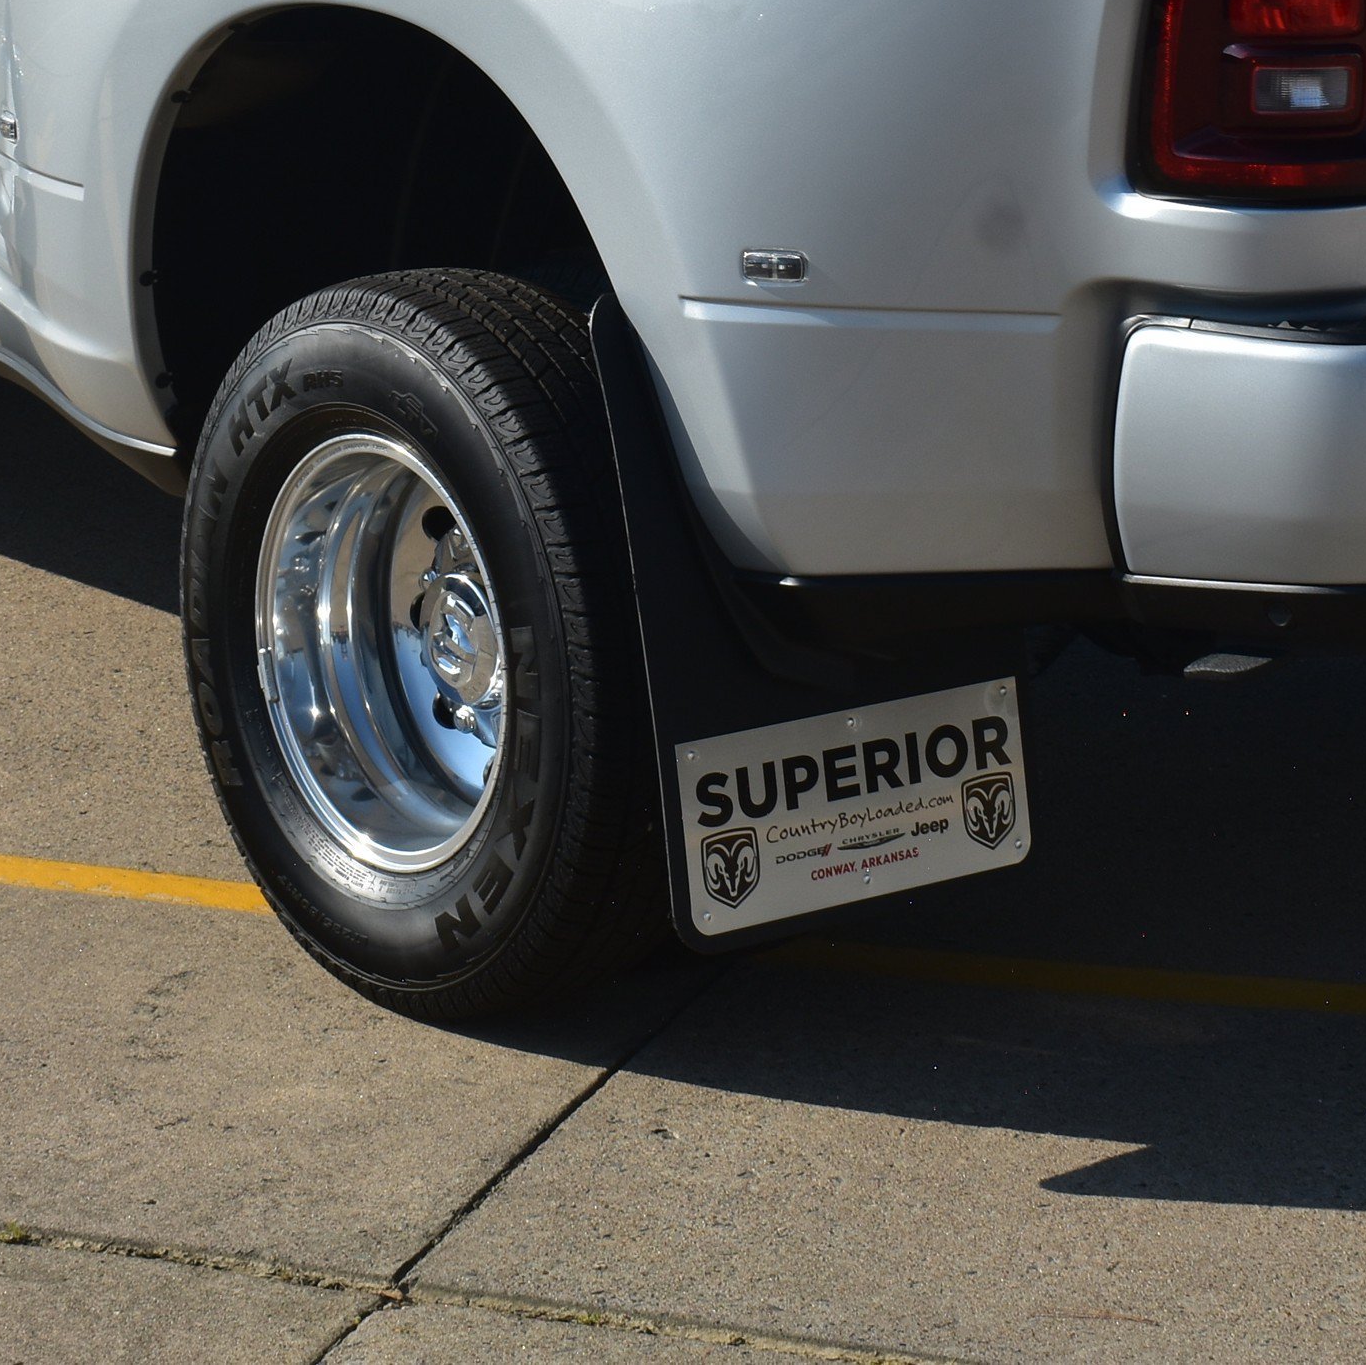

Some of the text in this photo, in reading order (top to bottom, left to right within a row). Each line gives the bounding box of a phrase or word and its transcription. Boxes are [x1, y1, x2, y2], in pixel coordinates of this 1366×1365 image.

[695, 715, 1012, 828] SUPERIOR
[766, 793, 954, 844] CountryBoyLoaded.com
[775, 817, 950, 865] DODGE CHRYSLER Jeep
[810, 846, 920, 882] CONWAY, ARKANSAS
